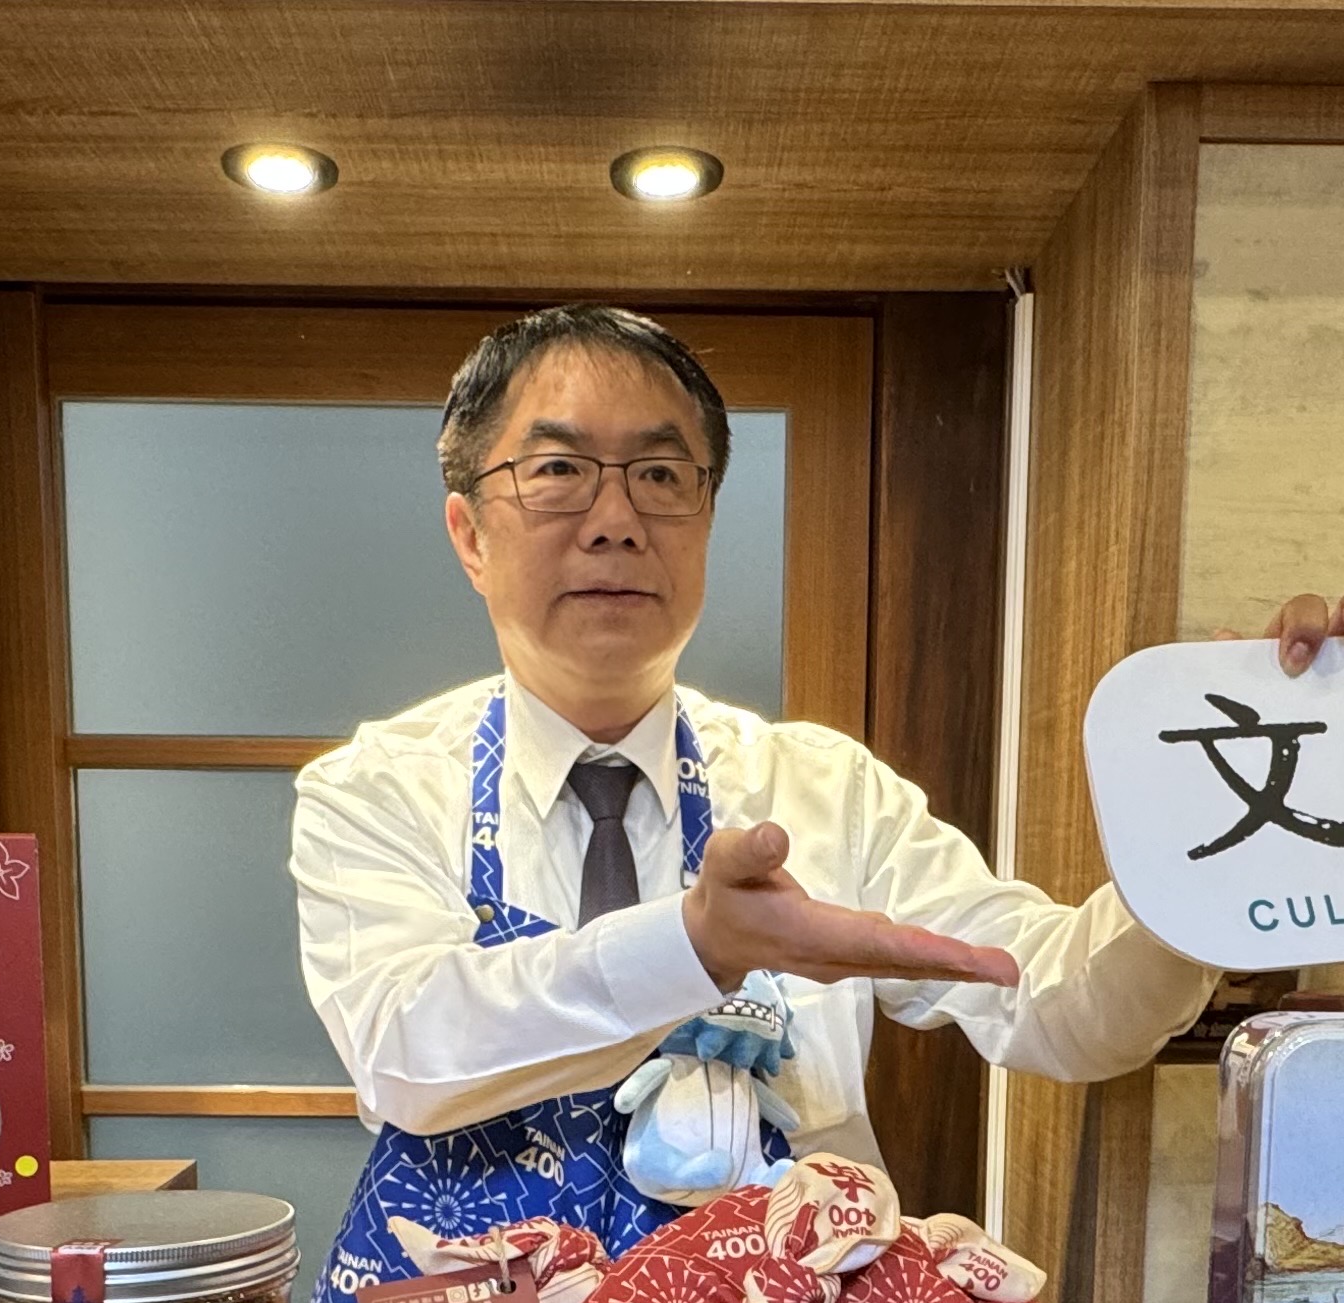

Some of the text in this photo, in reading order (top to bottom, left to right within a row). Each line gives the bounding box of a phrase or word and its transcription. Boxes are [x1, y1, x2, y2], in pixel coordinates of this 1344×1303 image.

[524, 1127, 566, 1162] TAINAN
[514, 1146, 565, 1188] 400
[828, 1204, 877, 1226] 400
[700, 1225, 761, 1242] TAINAN
[706, 1234, 766, 1262] 400
[959, 1262, 1002, 1293] 400
[967, 1251, 1009, 1281] TAINAN
